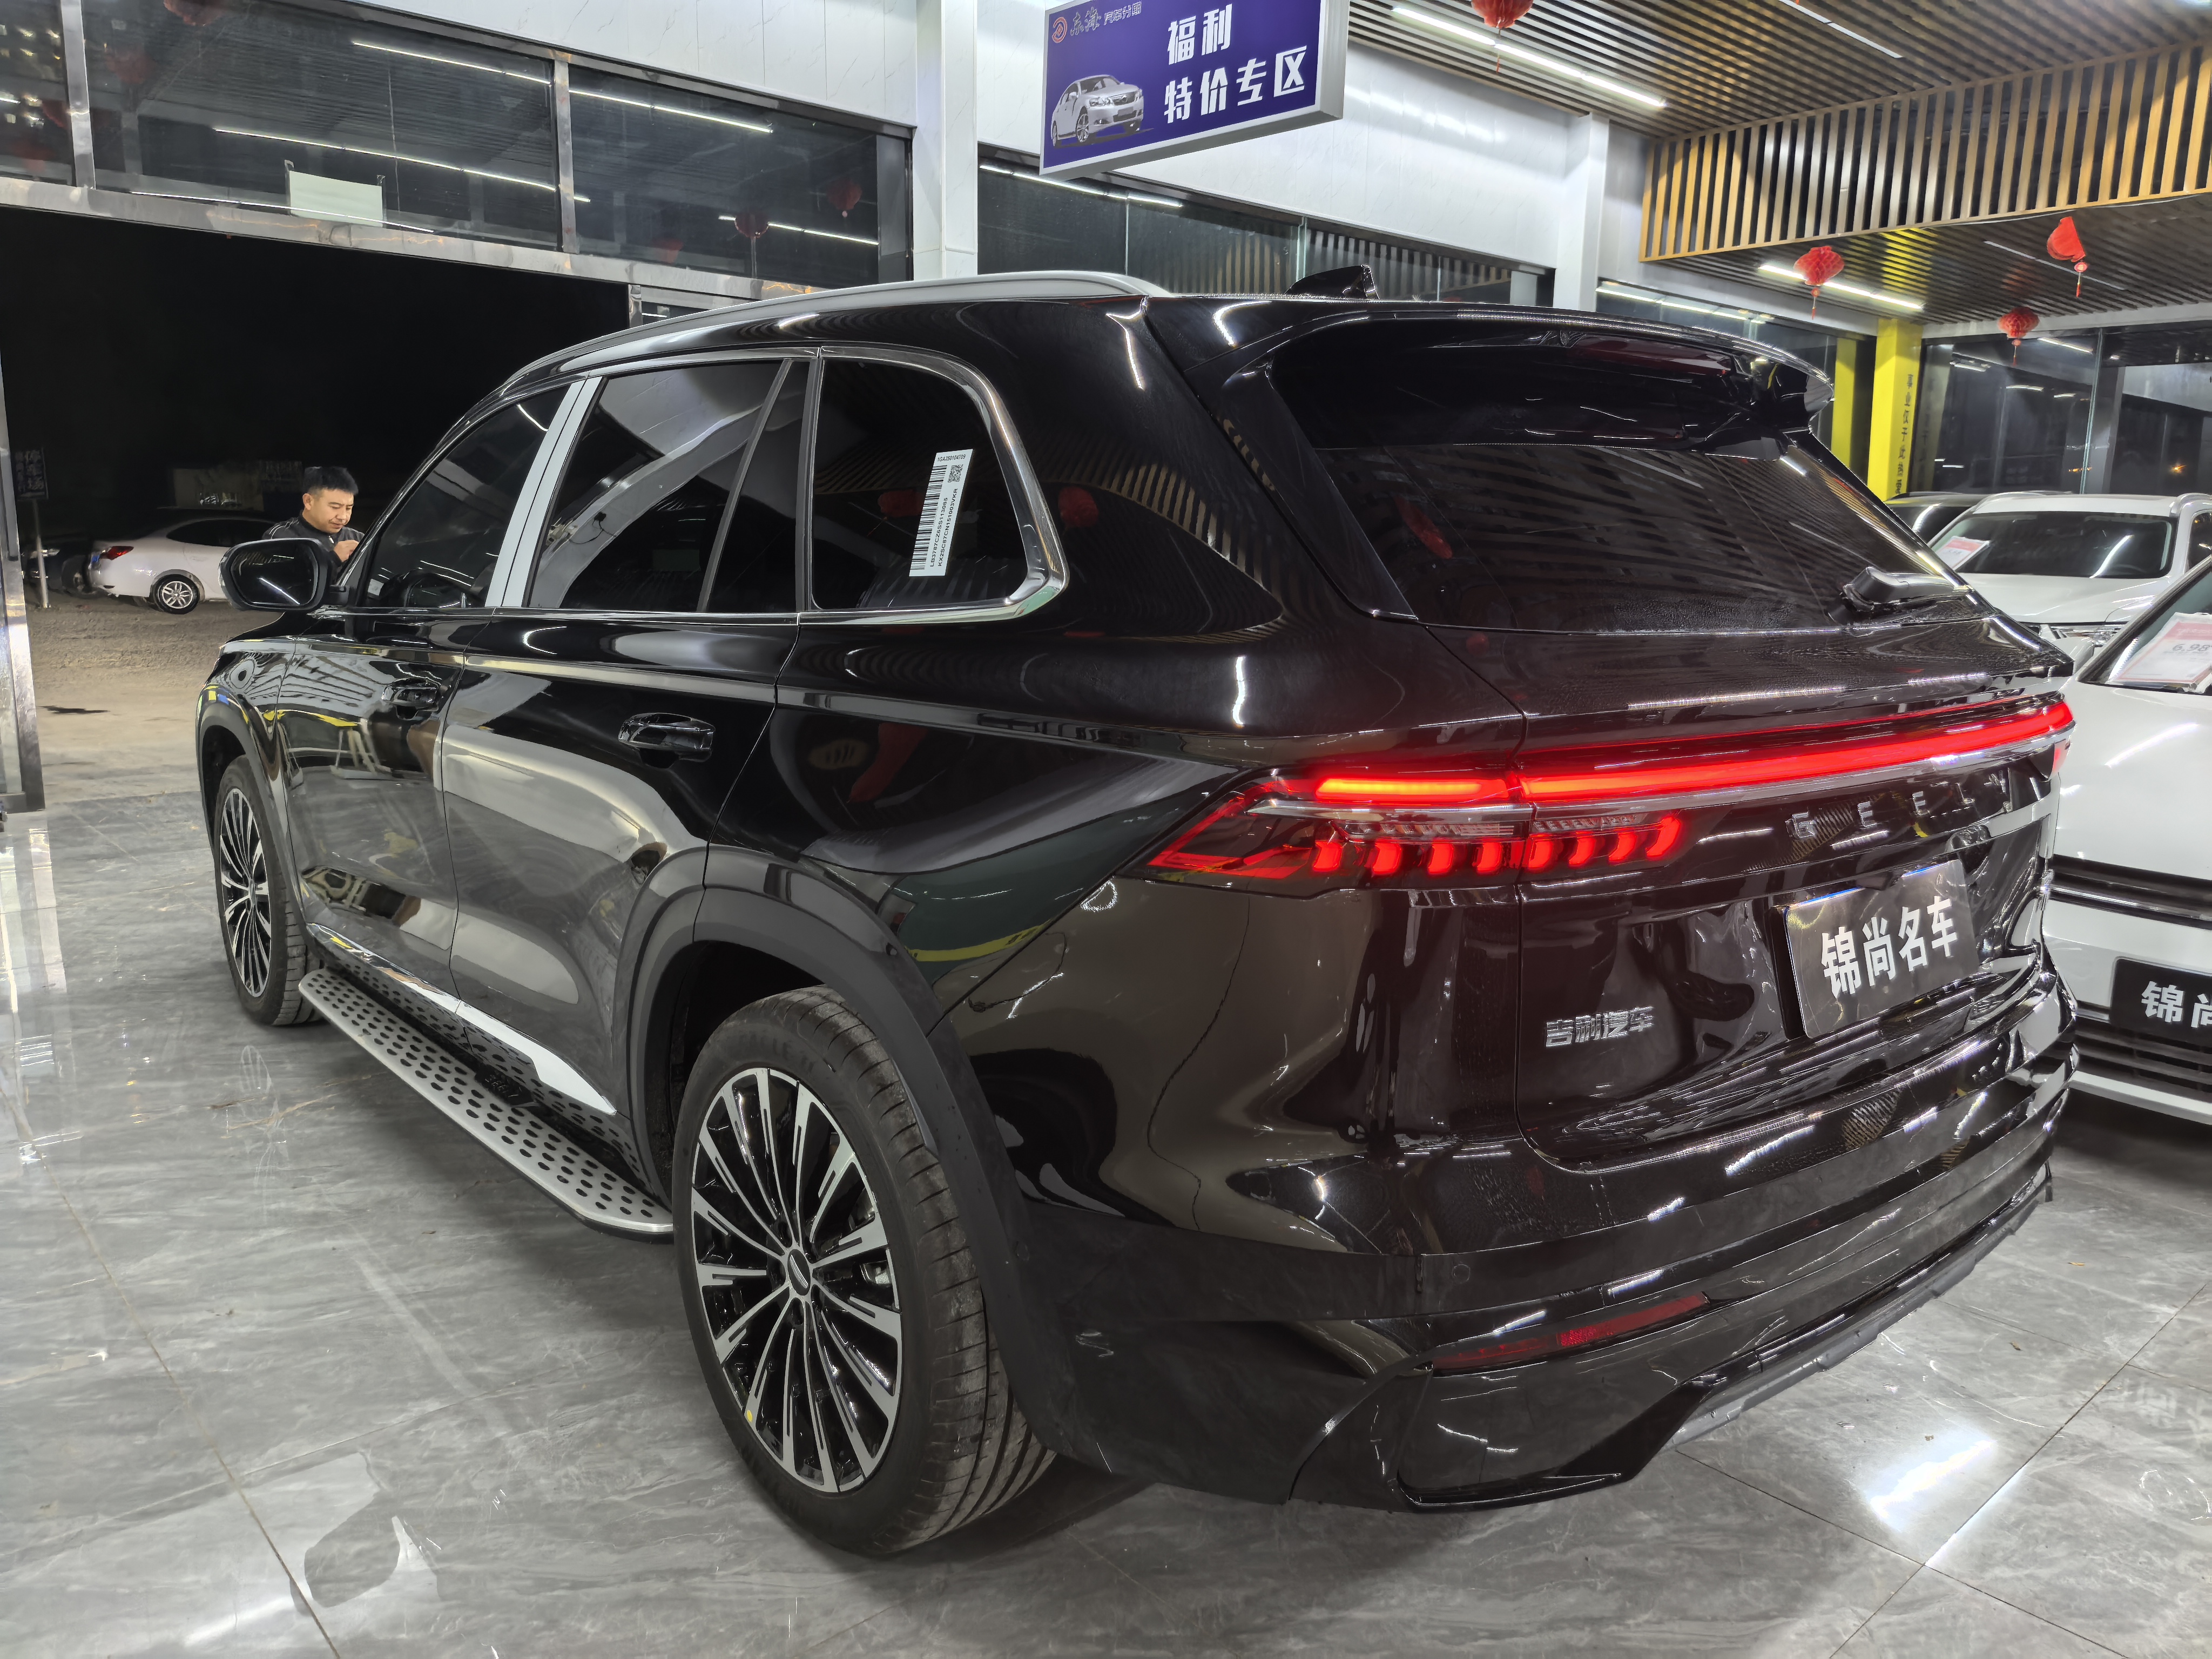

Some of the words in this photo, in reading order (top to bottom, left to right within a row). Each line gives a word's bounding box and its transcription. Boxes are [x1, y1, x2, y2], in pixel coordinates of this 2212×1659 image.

[1167, 3, 1233, 65] 福利
[1164, 45, 1307, 124] 特价专区
[1820, 894, 1959, 999] 锦尚名车
[1545, 1005, 1655, 1048] 吉利汽车
